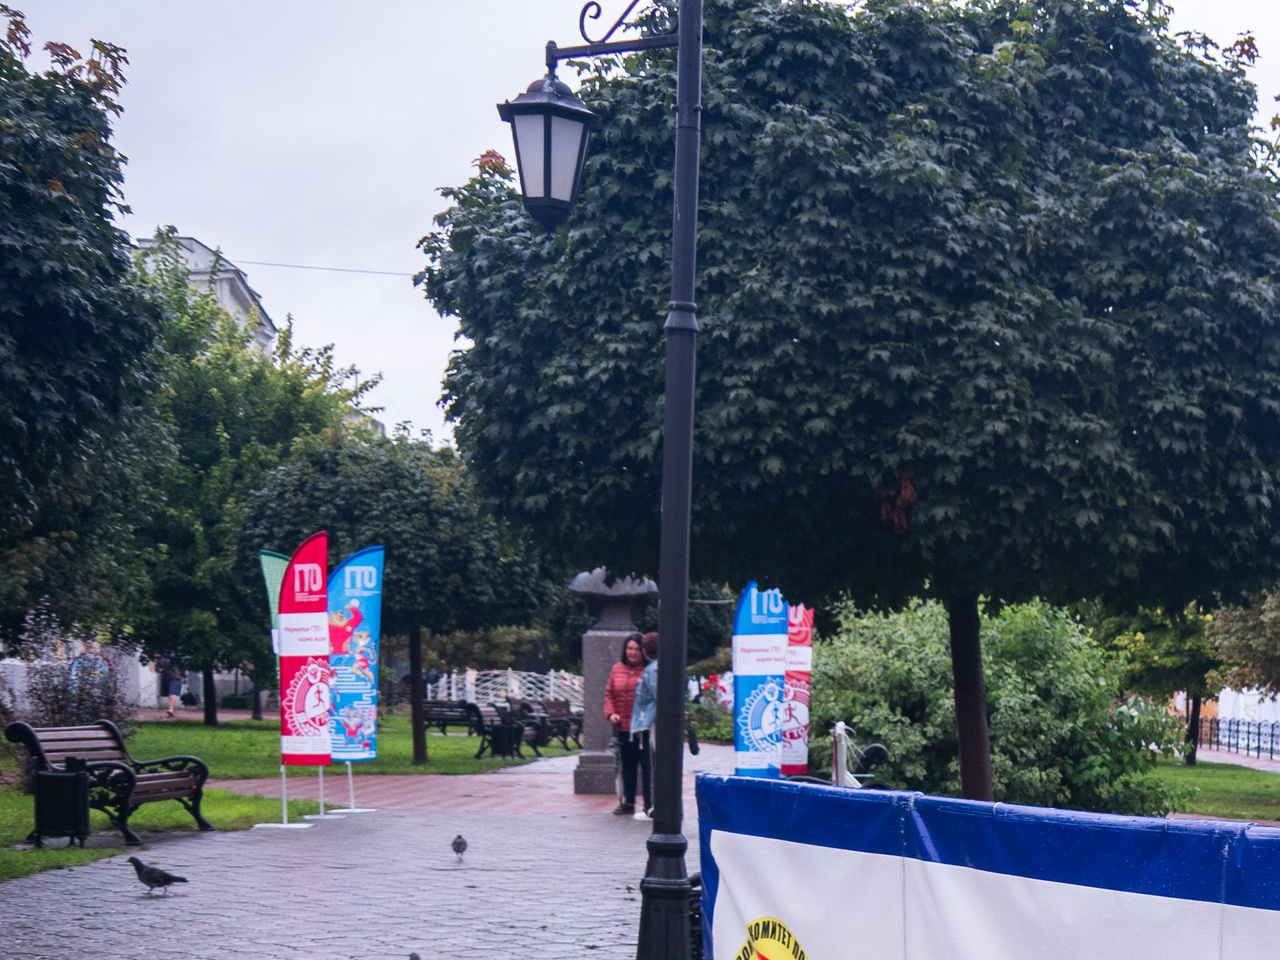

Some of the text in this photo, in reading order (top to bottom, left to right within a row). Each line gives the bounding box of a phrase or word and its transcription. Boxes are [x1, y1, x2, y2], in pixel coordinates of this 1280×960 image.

[293, 562, 323, 592] ГТО
[344, 565, 378, 589] ГТО
[748, 920, 792, 950] КОМИТЕТ
